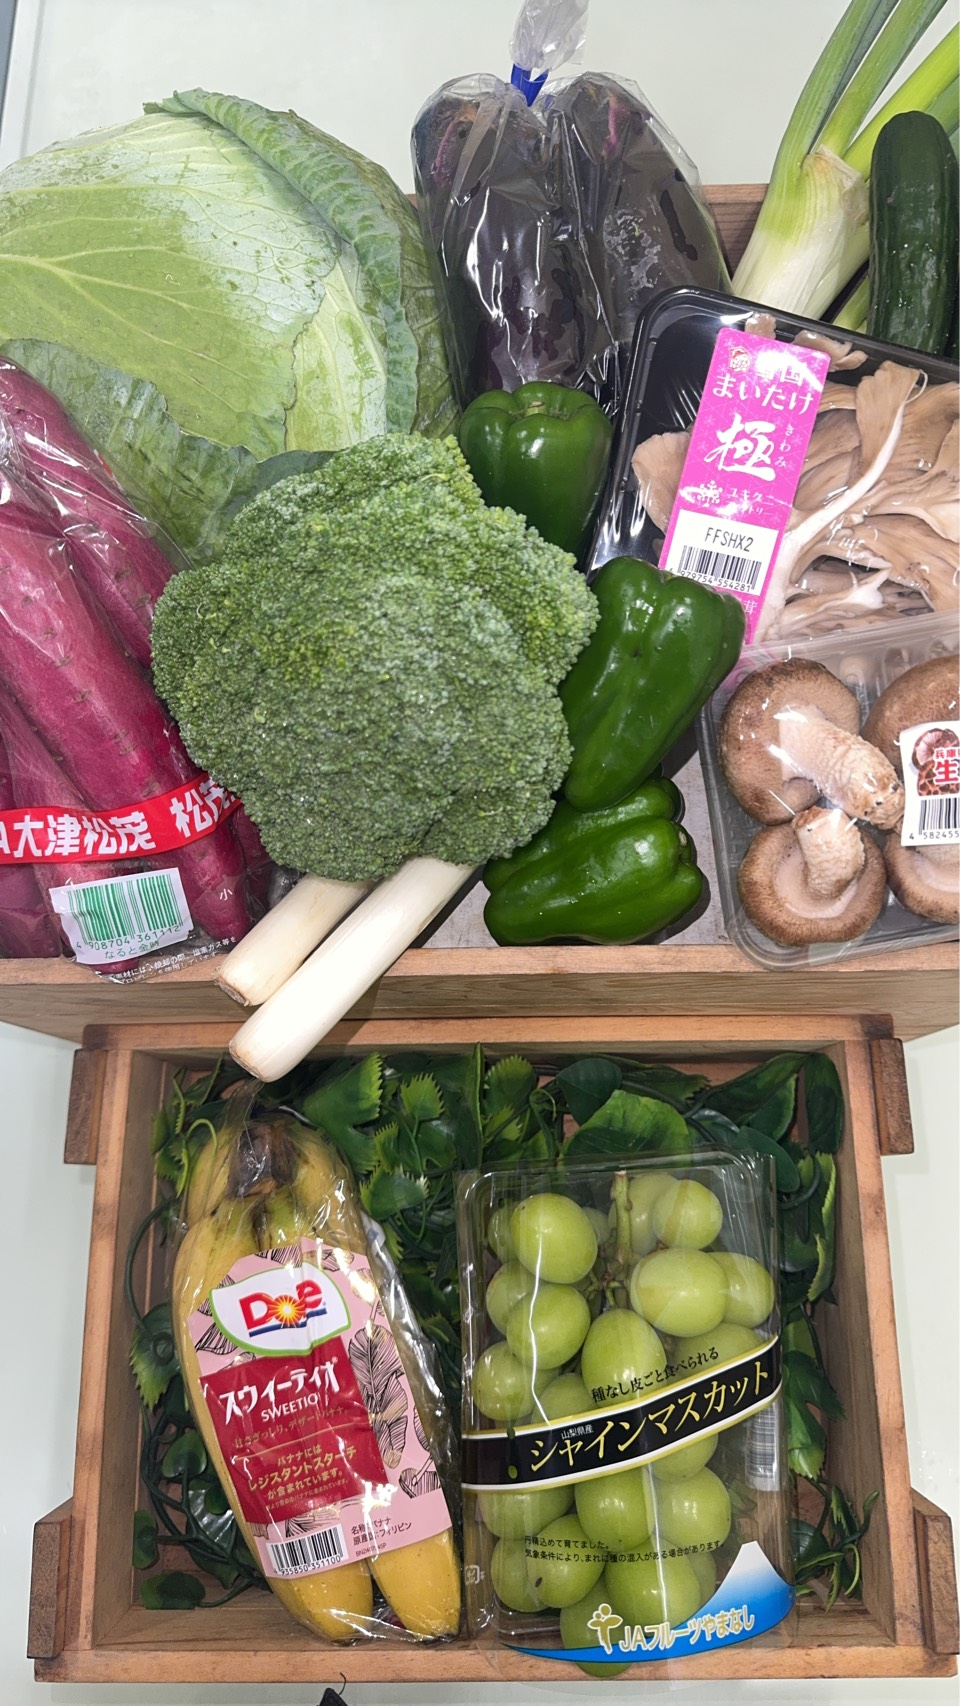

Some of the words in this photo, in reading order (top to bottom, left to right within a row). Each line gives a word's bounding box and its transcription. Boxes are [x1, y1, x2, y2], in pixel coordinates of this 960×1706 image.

[713, 372, 814, 415] まいたけ
[704, 413, 777, 482] 極
[775, 424, 795, 468] きわみ
[705, 527, 754, 552] FFSHX2
[681, 570, 713, 585] 979754
[717, 578, 751, 593] 554281
[935, 749, 960, 759] 兵庫
[935, 759, 959, 783] 生
[88, 938, 130, 950] 908704
[136, 925, 180, 942] 361112
[239, 1279, 324, 1331] Dole
[591, 1346, 719, 1403] 種なし皮ごと食べられる
[261, 1393, 319, 1422] SWEETIO
[530, 1361, 769, 1472] シャインマスカット
[560, 1424, 594, 1440] 山梨県産
[248, 1445, 357, 1491] レジスタントスターチ
[277, 1443, 323, 1467] バナナには
[267, 1467, 343, 1500] が含まれています。
[280, 1564, 309, 1576] 935850
[311, 1554, 341, 1570] 351100
[619, 1604, 755, 1652] JAフルーツやまなし
